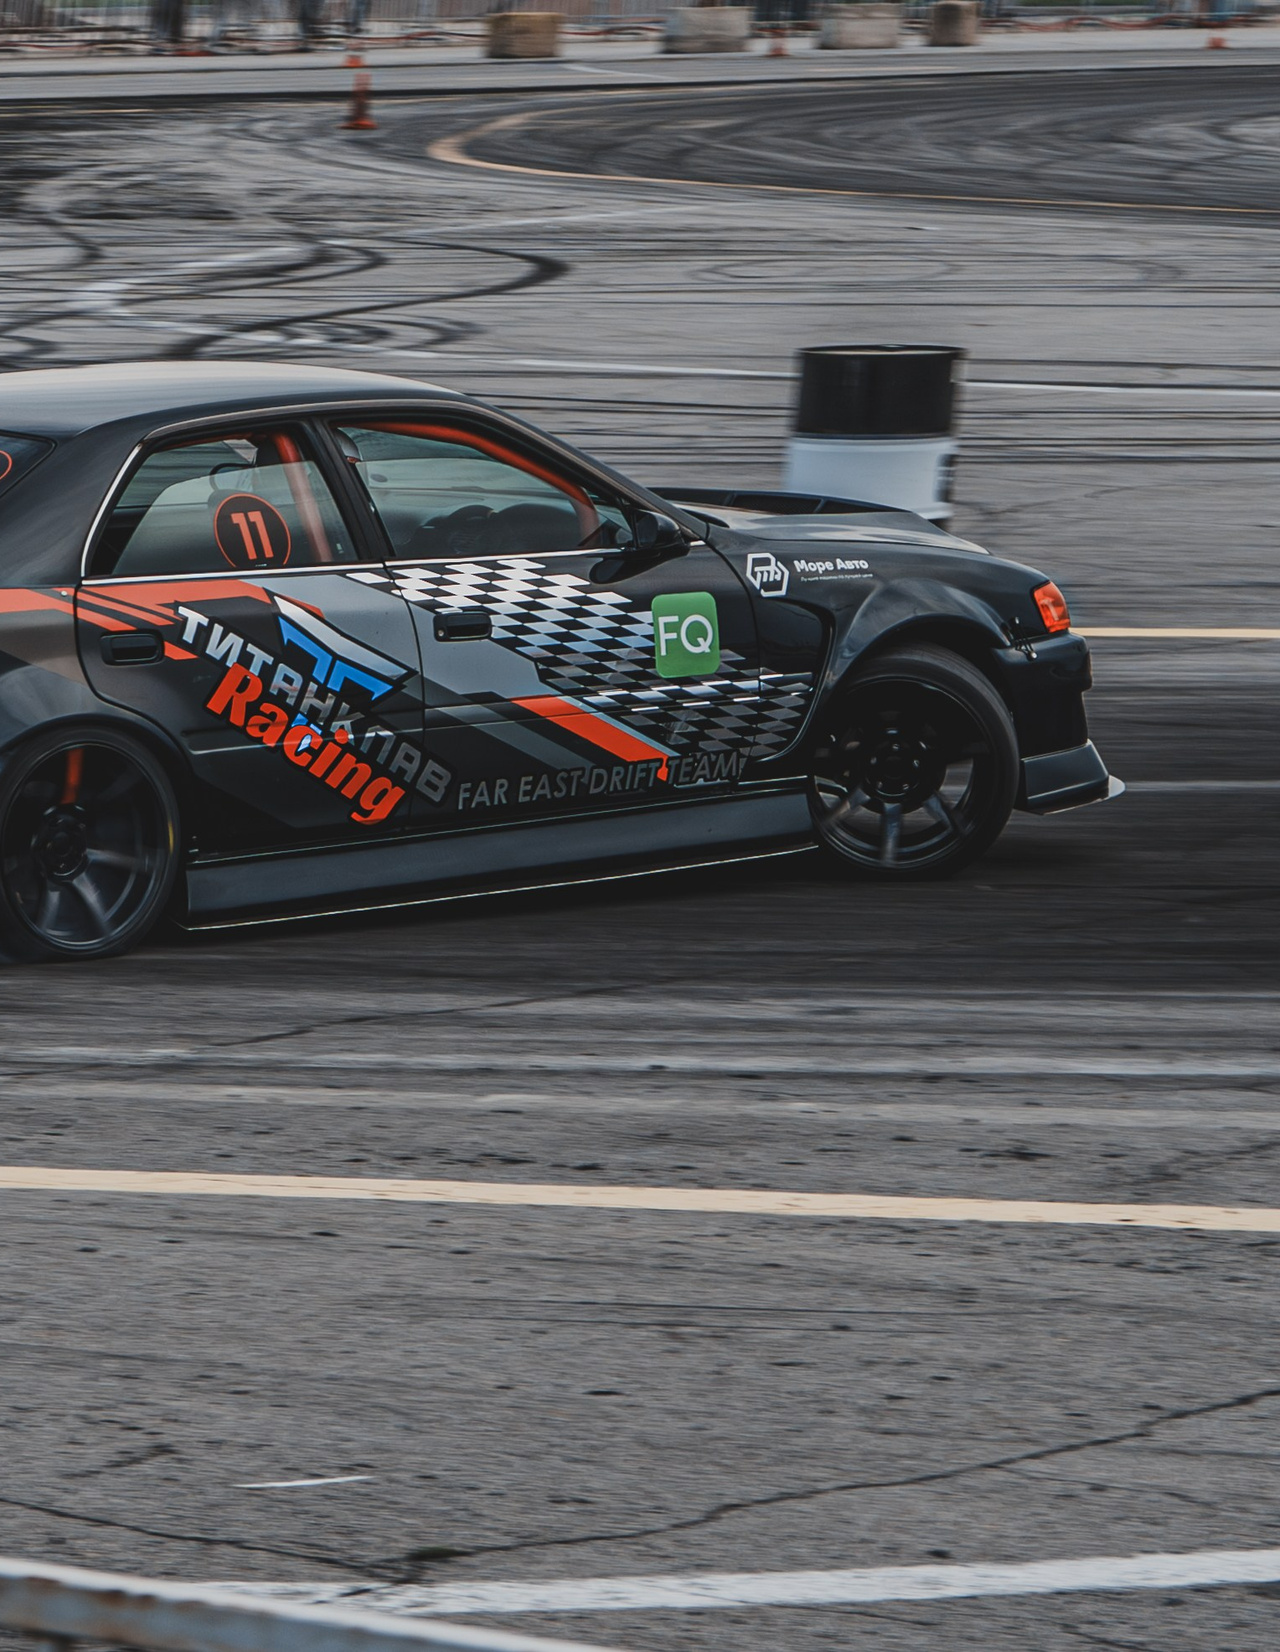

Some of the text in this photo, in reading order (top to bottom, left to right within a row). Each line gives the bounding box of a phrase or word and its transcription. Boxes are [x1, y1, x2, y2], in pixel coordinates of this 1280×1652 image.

[230, 511, 275, 561] 11
[793, 557, 869, 575] Море Авто
[657, 614, 714, 657] FQ
[206, 662, 406, 825] Racing
[458, 752, 740, 811] FAR EAST DRIFT TEAM
